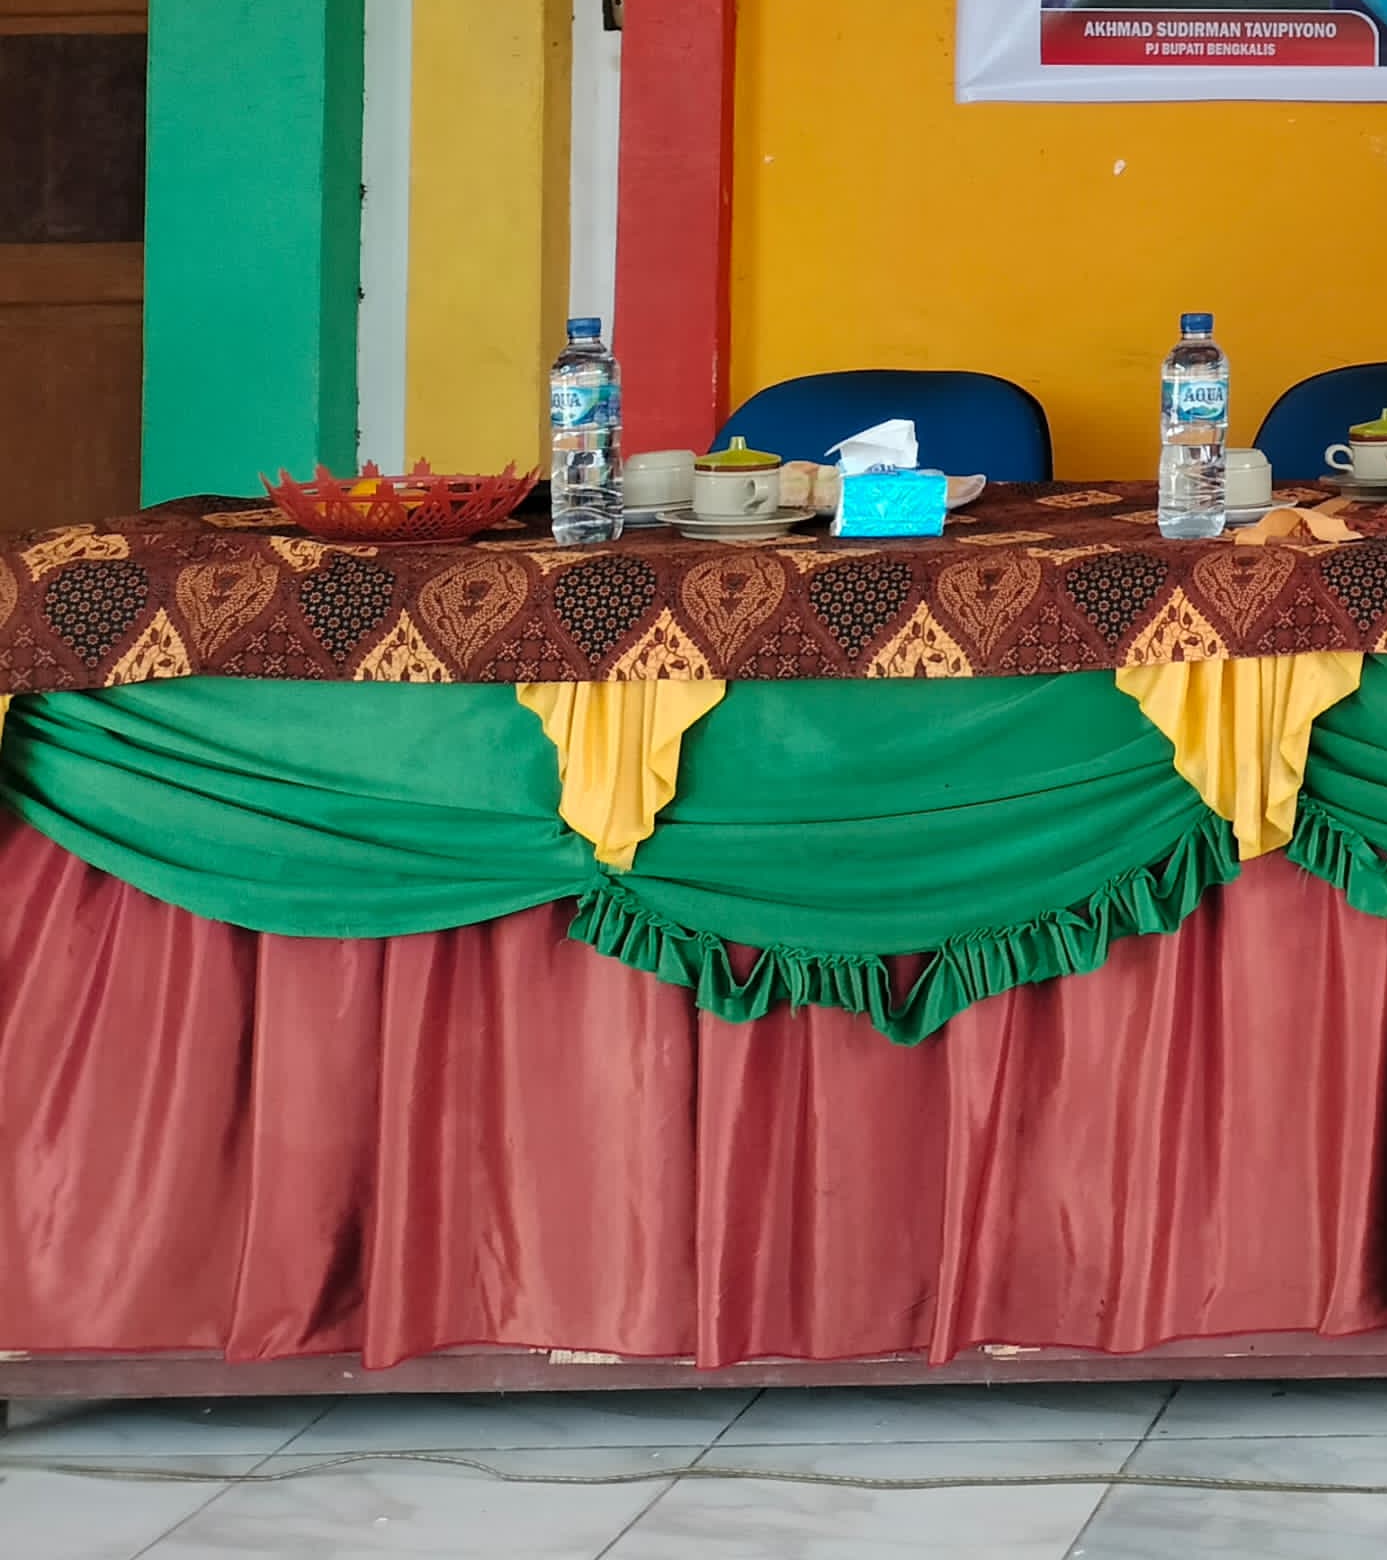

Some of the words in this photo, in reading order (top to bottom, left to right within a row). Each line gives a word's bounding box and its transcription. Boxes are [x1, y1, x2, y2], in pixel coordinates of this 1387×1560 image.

[1084, 21, 1153, 38] AKHMAD
[1156, 21, 1242, 39] SUDIRMAN
[1244, 22, 1337, 40] TAVIPIYONO
[1145, 43, 1160, 56] PJ
[1162, 43, 1204, 56] BUPATI
[1207, 43, 1277, 57] BENGKALIS
[1183, 387, 1224, 404] AQUA
